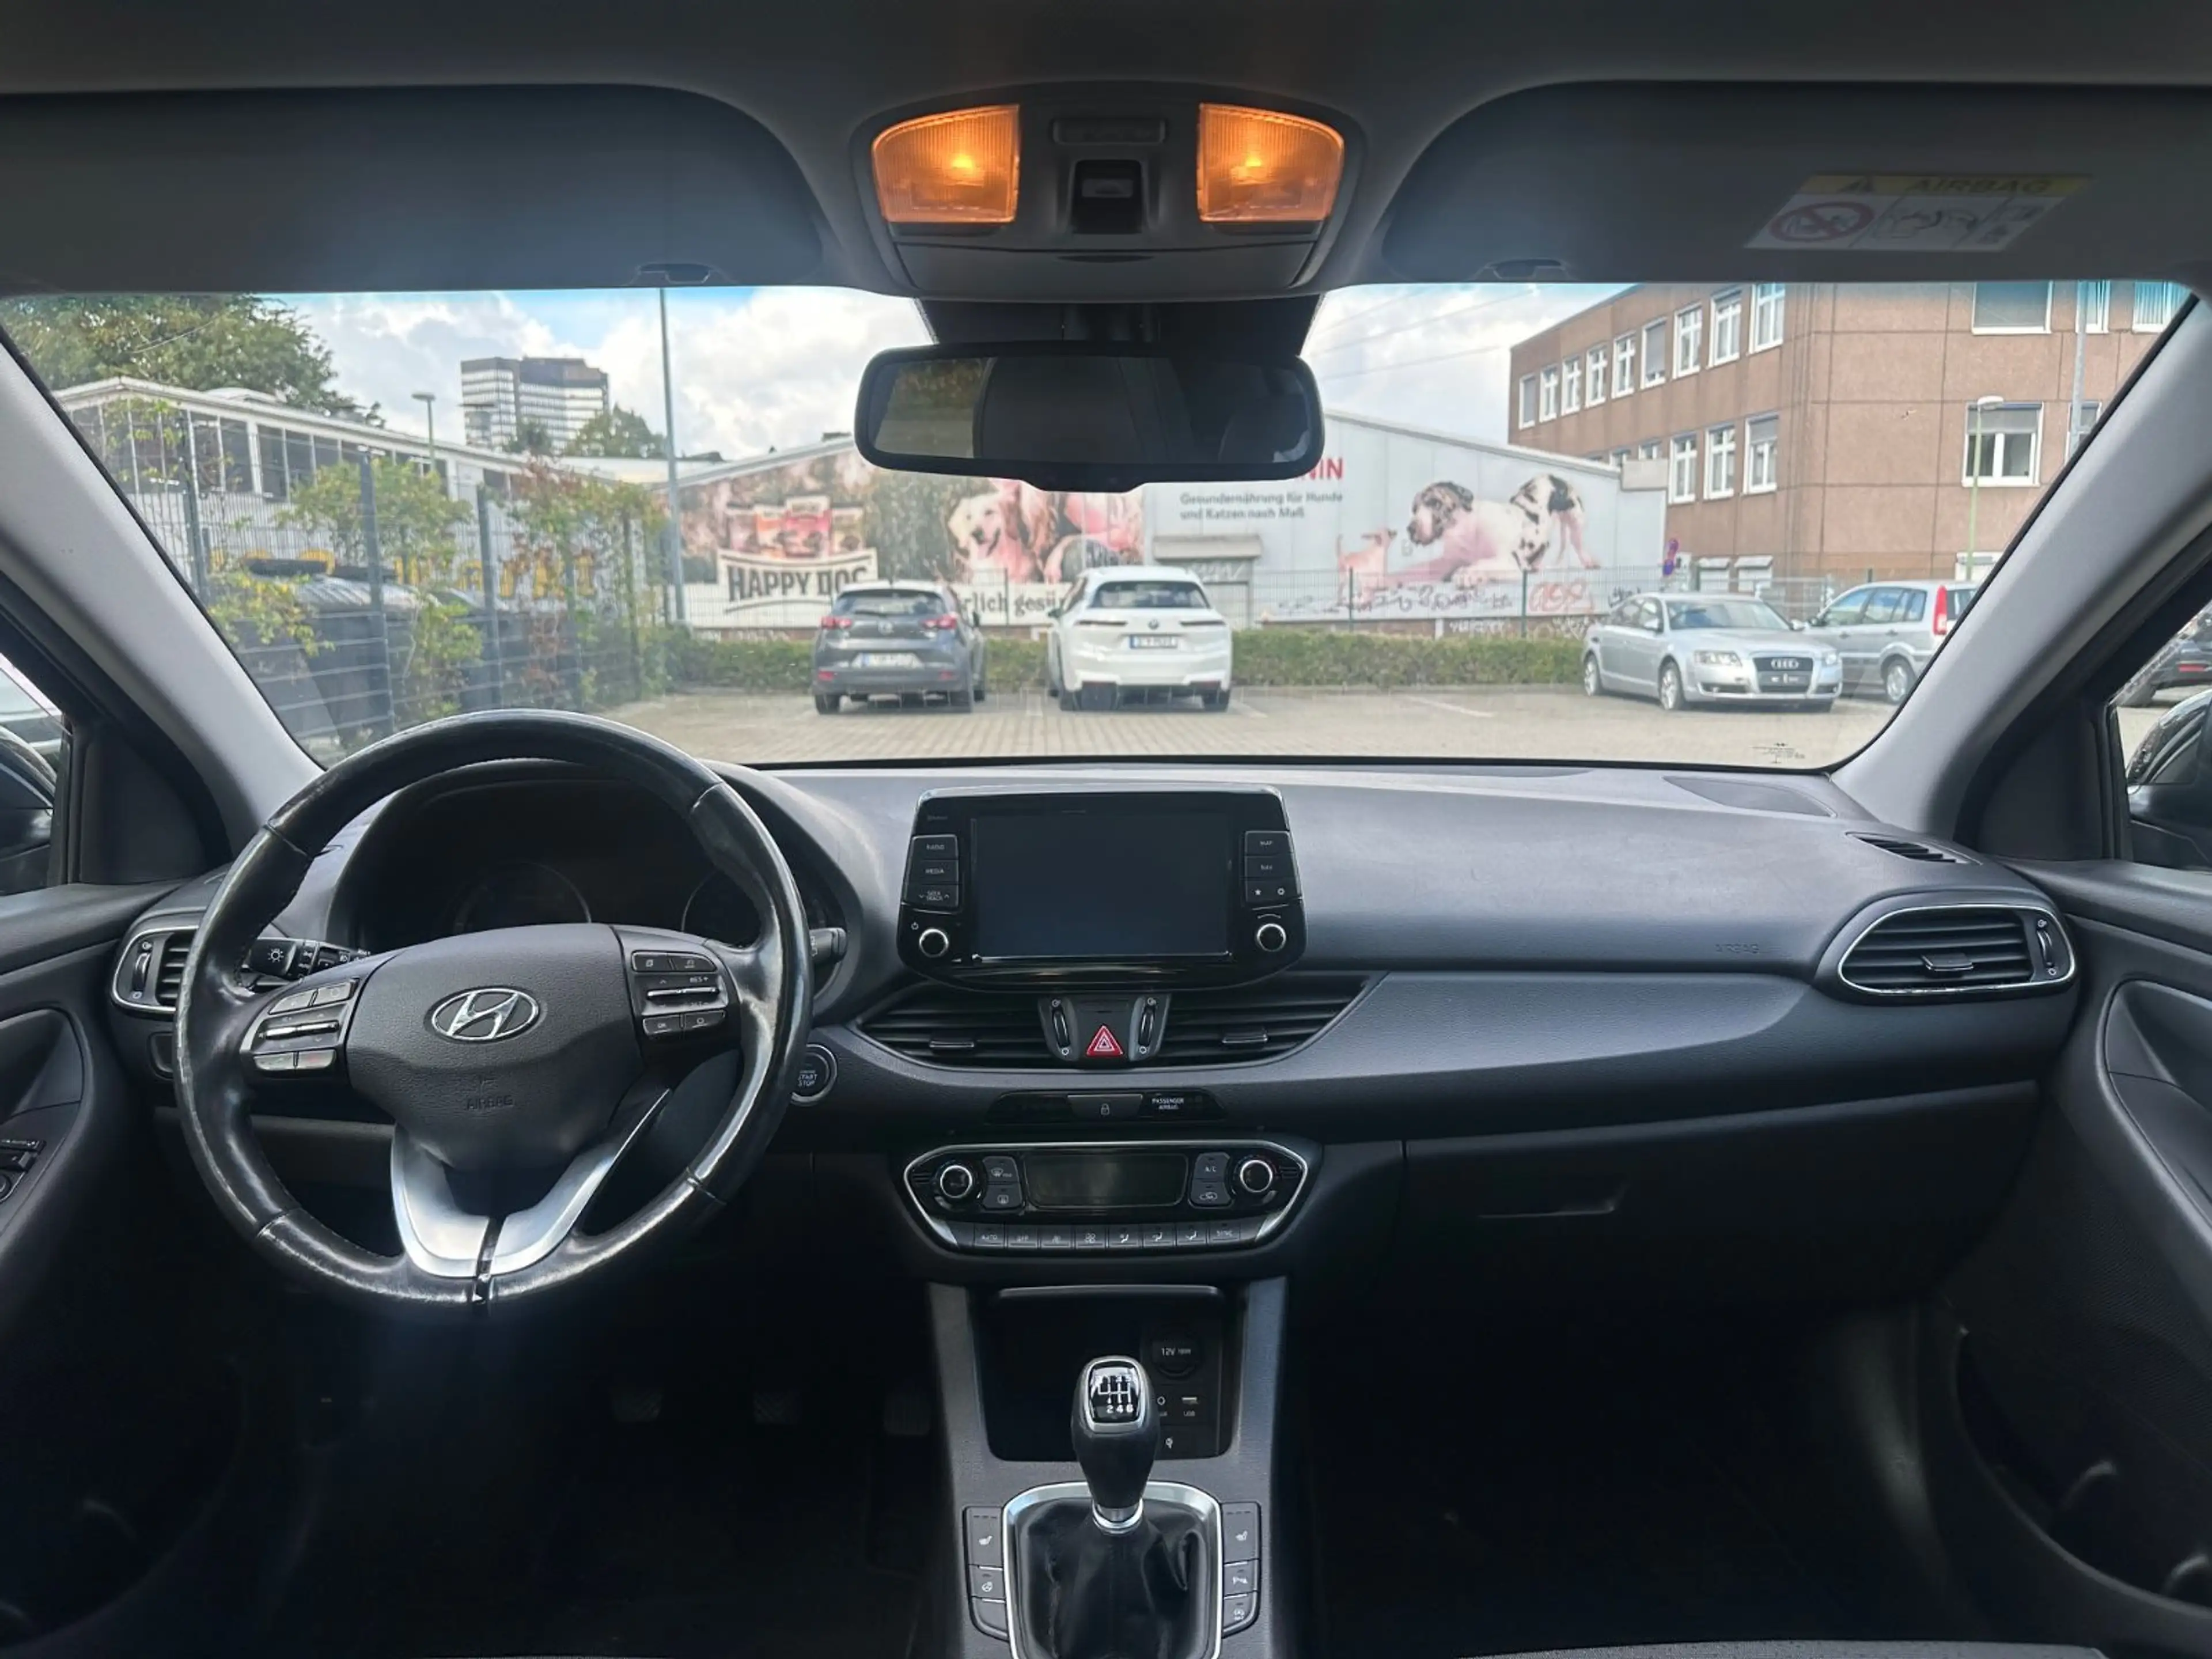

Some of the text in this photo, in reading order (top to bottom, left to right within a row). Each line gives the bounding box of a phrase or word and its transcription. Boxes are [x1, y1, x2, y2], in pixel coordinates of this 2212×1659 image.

[1903, 179, 2051, 194] AIRBAG
[1180, 492, 1343, 505] Gesundernährung für Hunde
[1180, 509, 1202, 519] und
[1205, 508, 1244, 518] Katzen
[1248, 508, 1275, 518] nach
[728, 566, 809, 601] HAPPY
[963, 591, 1007, 612] rlich
[1161, 1348, 1175, 1356] 12V
[1107, 1404, 1113, 1414] 2
[1116, 1404, 1124, 1414] 4
